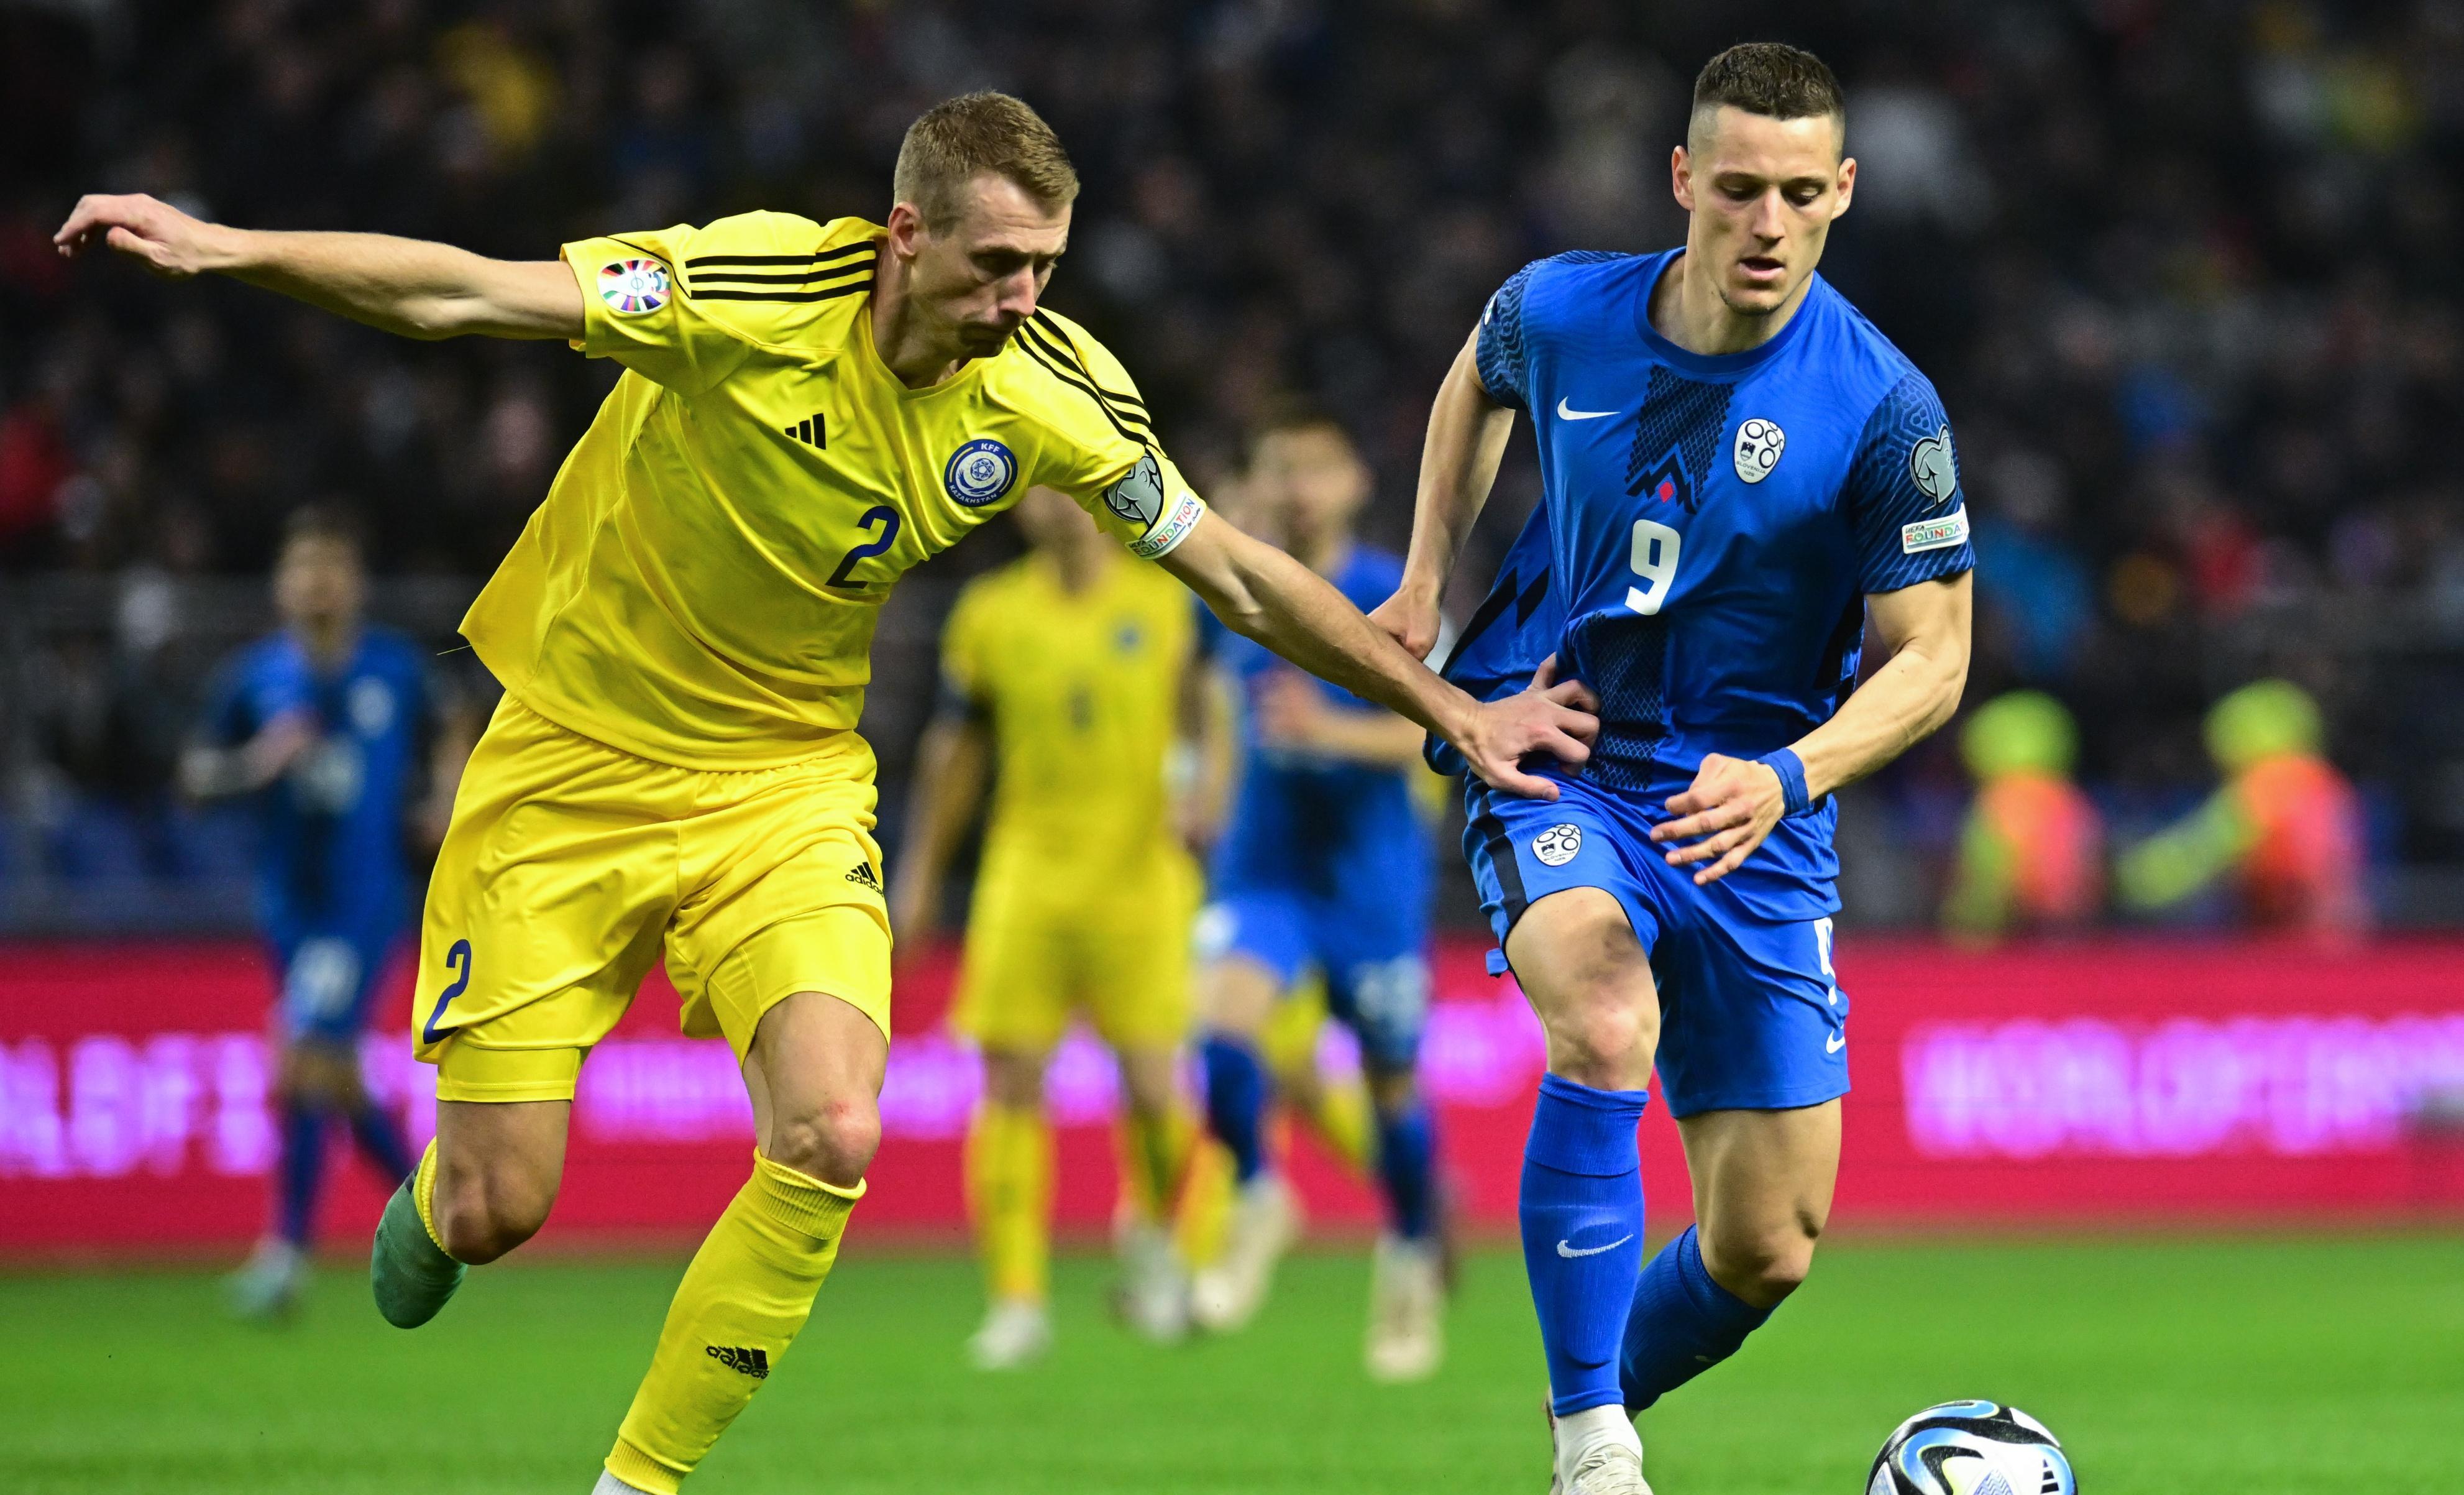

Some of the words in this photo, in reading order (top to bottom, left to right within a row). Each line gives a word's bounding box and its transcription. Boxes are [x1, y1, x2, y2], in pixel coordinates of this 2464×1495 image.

[981, 442, 1001, 453] KFF
[949, 484, 997, 504] KAZAKHSTAN
[1133, 498, 1195, 555] FOUNDATION
[1905, 525, 1925, 534] UEFA
[825, 505, 900, 590] 2
[1624, 519, 1681, 615] 9
[845, 873, 884, 898] adidas
[423, 939, 472, 1045] 2
[705, 1346, 770, 1379] adidas
